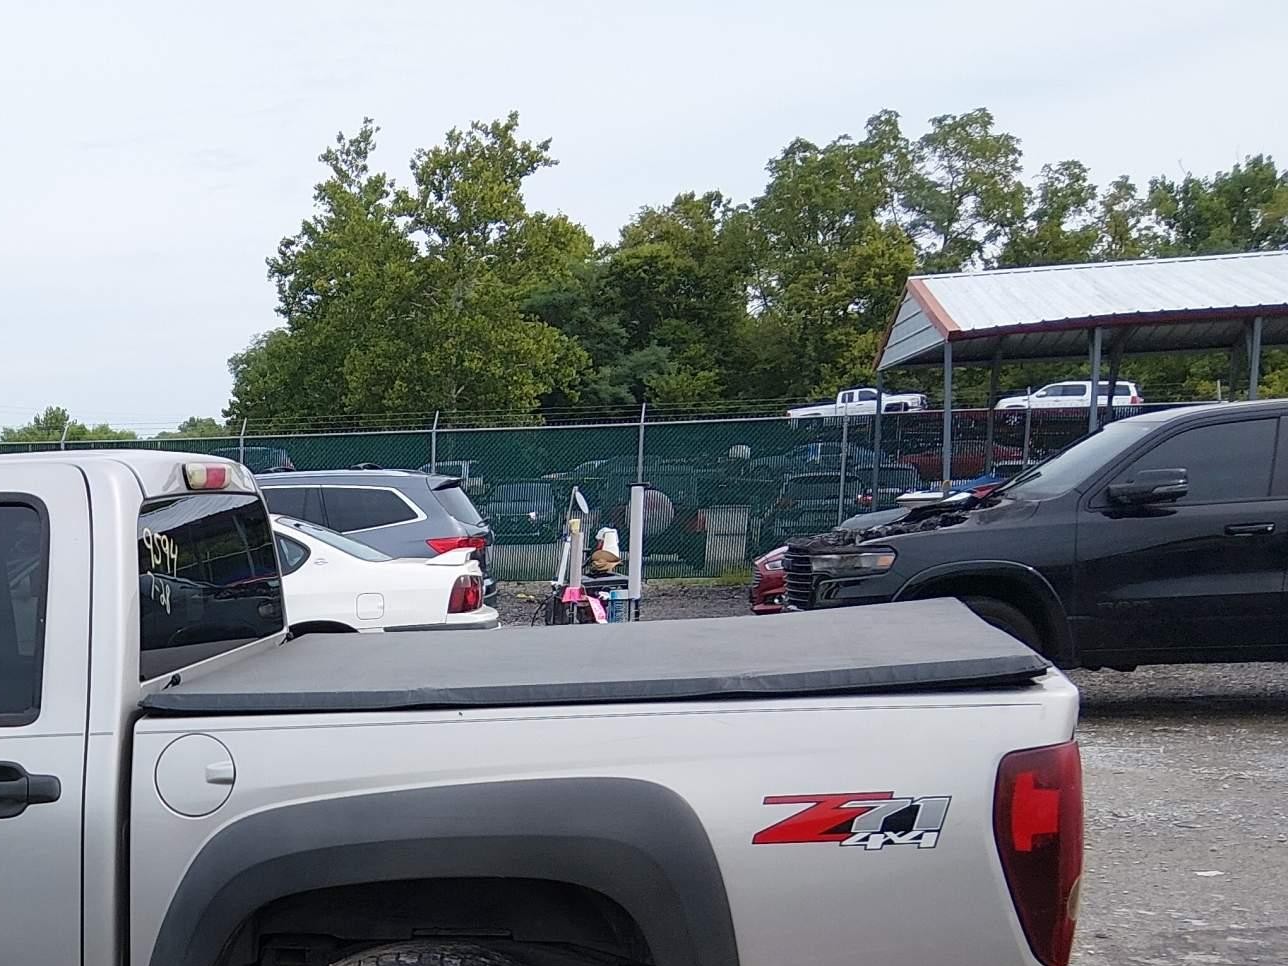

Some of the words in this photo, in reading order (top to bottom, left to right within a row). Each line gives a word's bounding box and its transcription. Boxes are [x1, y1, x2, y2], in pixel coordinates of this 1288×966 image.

[143, 528, 178, 578] 9594
[147, 571, 171, 615] 7-28
[752, 791, 952, 845] Z71
